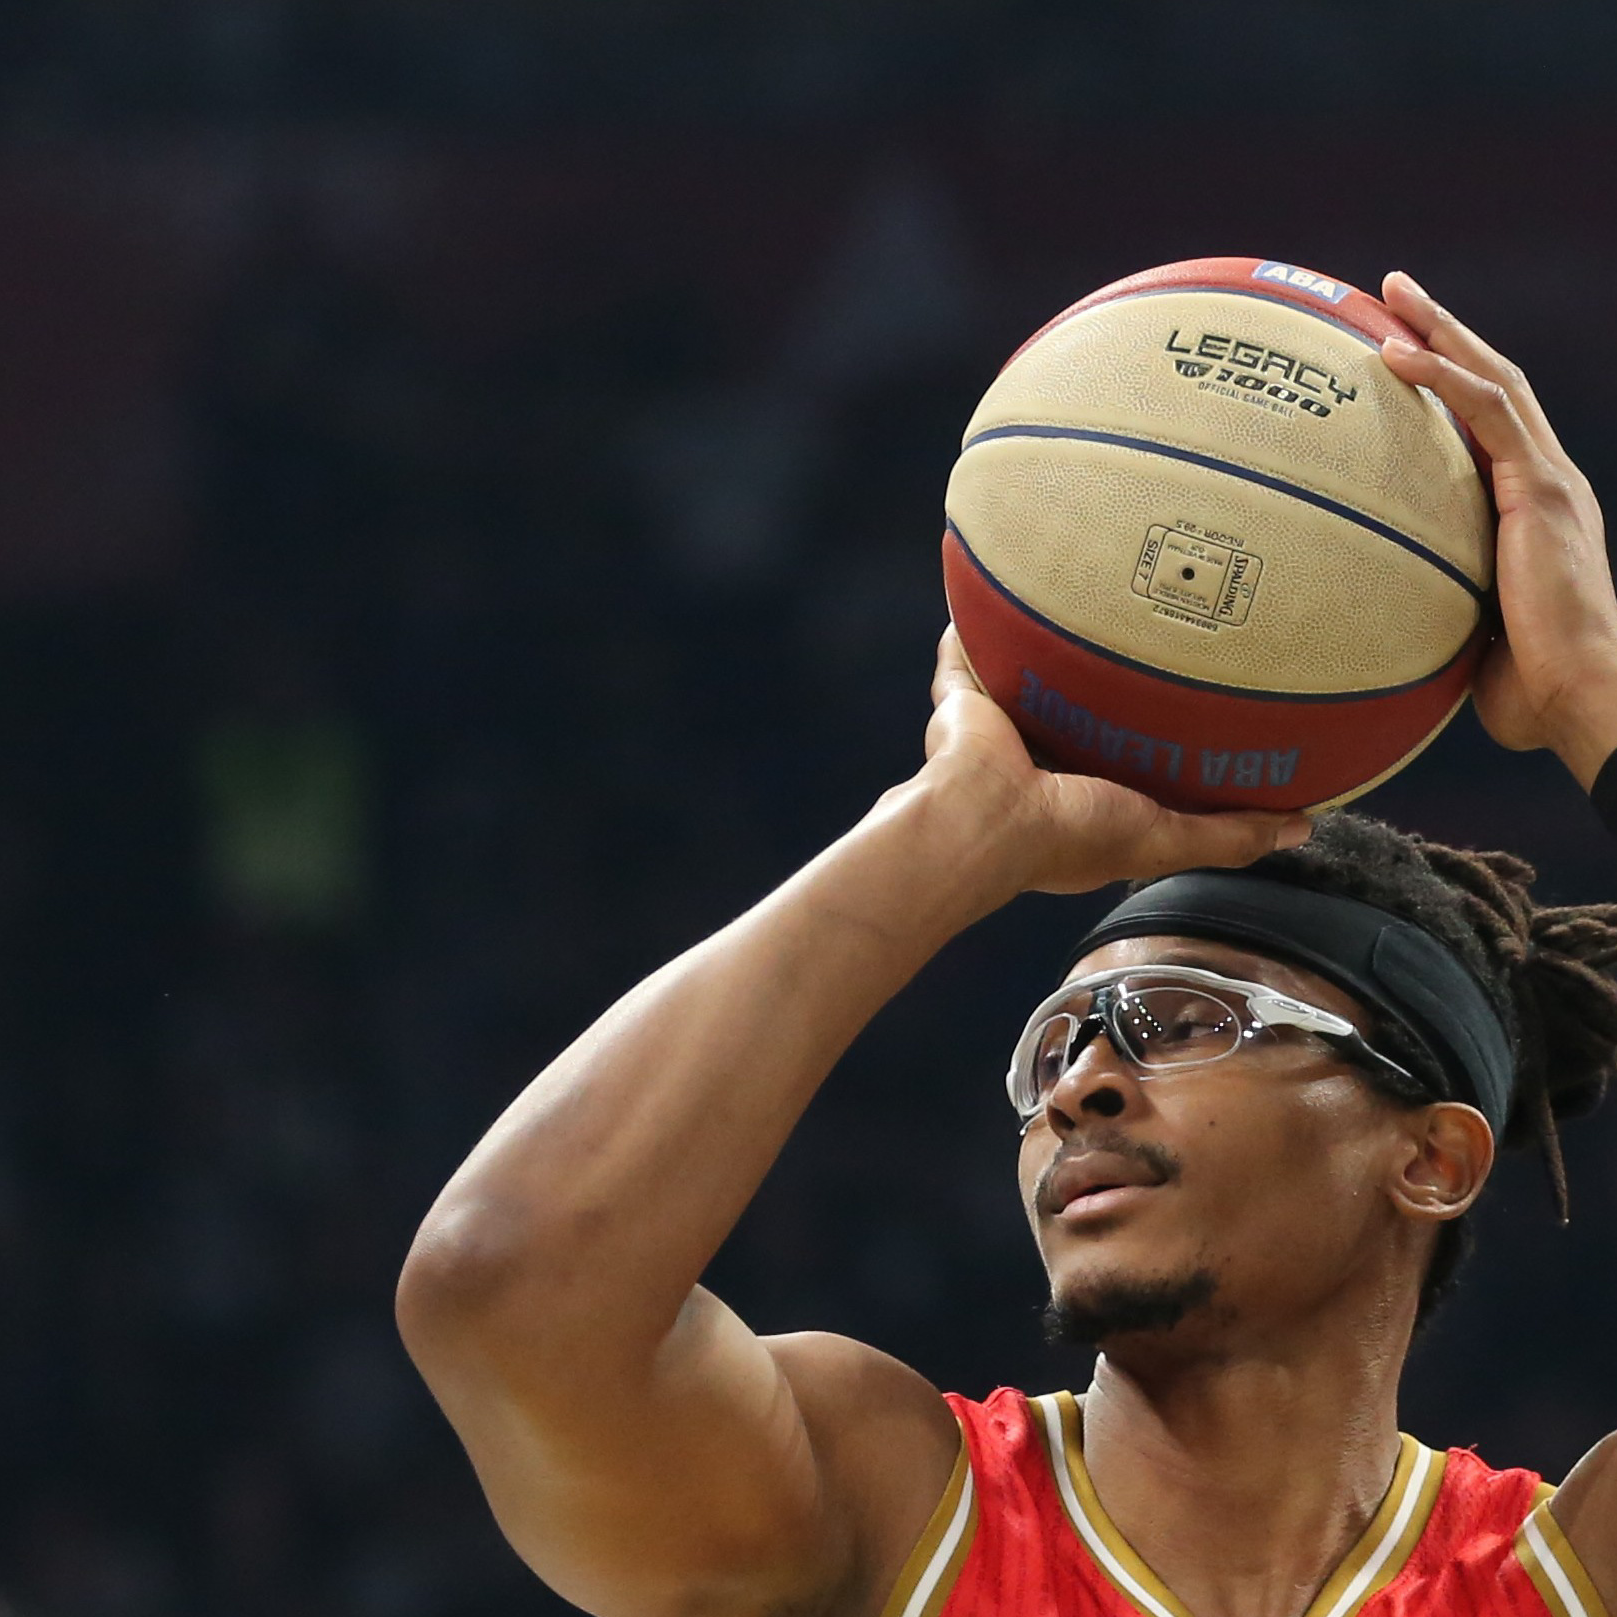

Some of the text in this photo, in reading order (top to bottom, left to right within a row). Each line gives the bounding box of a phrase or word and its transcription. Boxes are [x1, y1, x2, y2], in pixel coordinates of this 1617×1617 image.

[1263, 265, 1336, 298] ABA
[1164, 329, 1358, 405] LEGACY
[1216, 367, 1332, 418] 1000
[1197, 381, 1295, 419] OFFICIAL GAME BALL
[1138, 540, 1158, 580] SIZE 7
[1219, 555, 1249, 616] SPALDING
[1019, 667, 1301, 789] ABA LEAGUE
